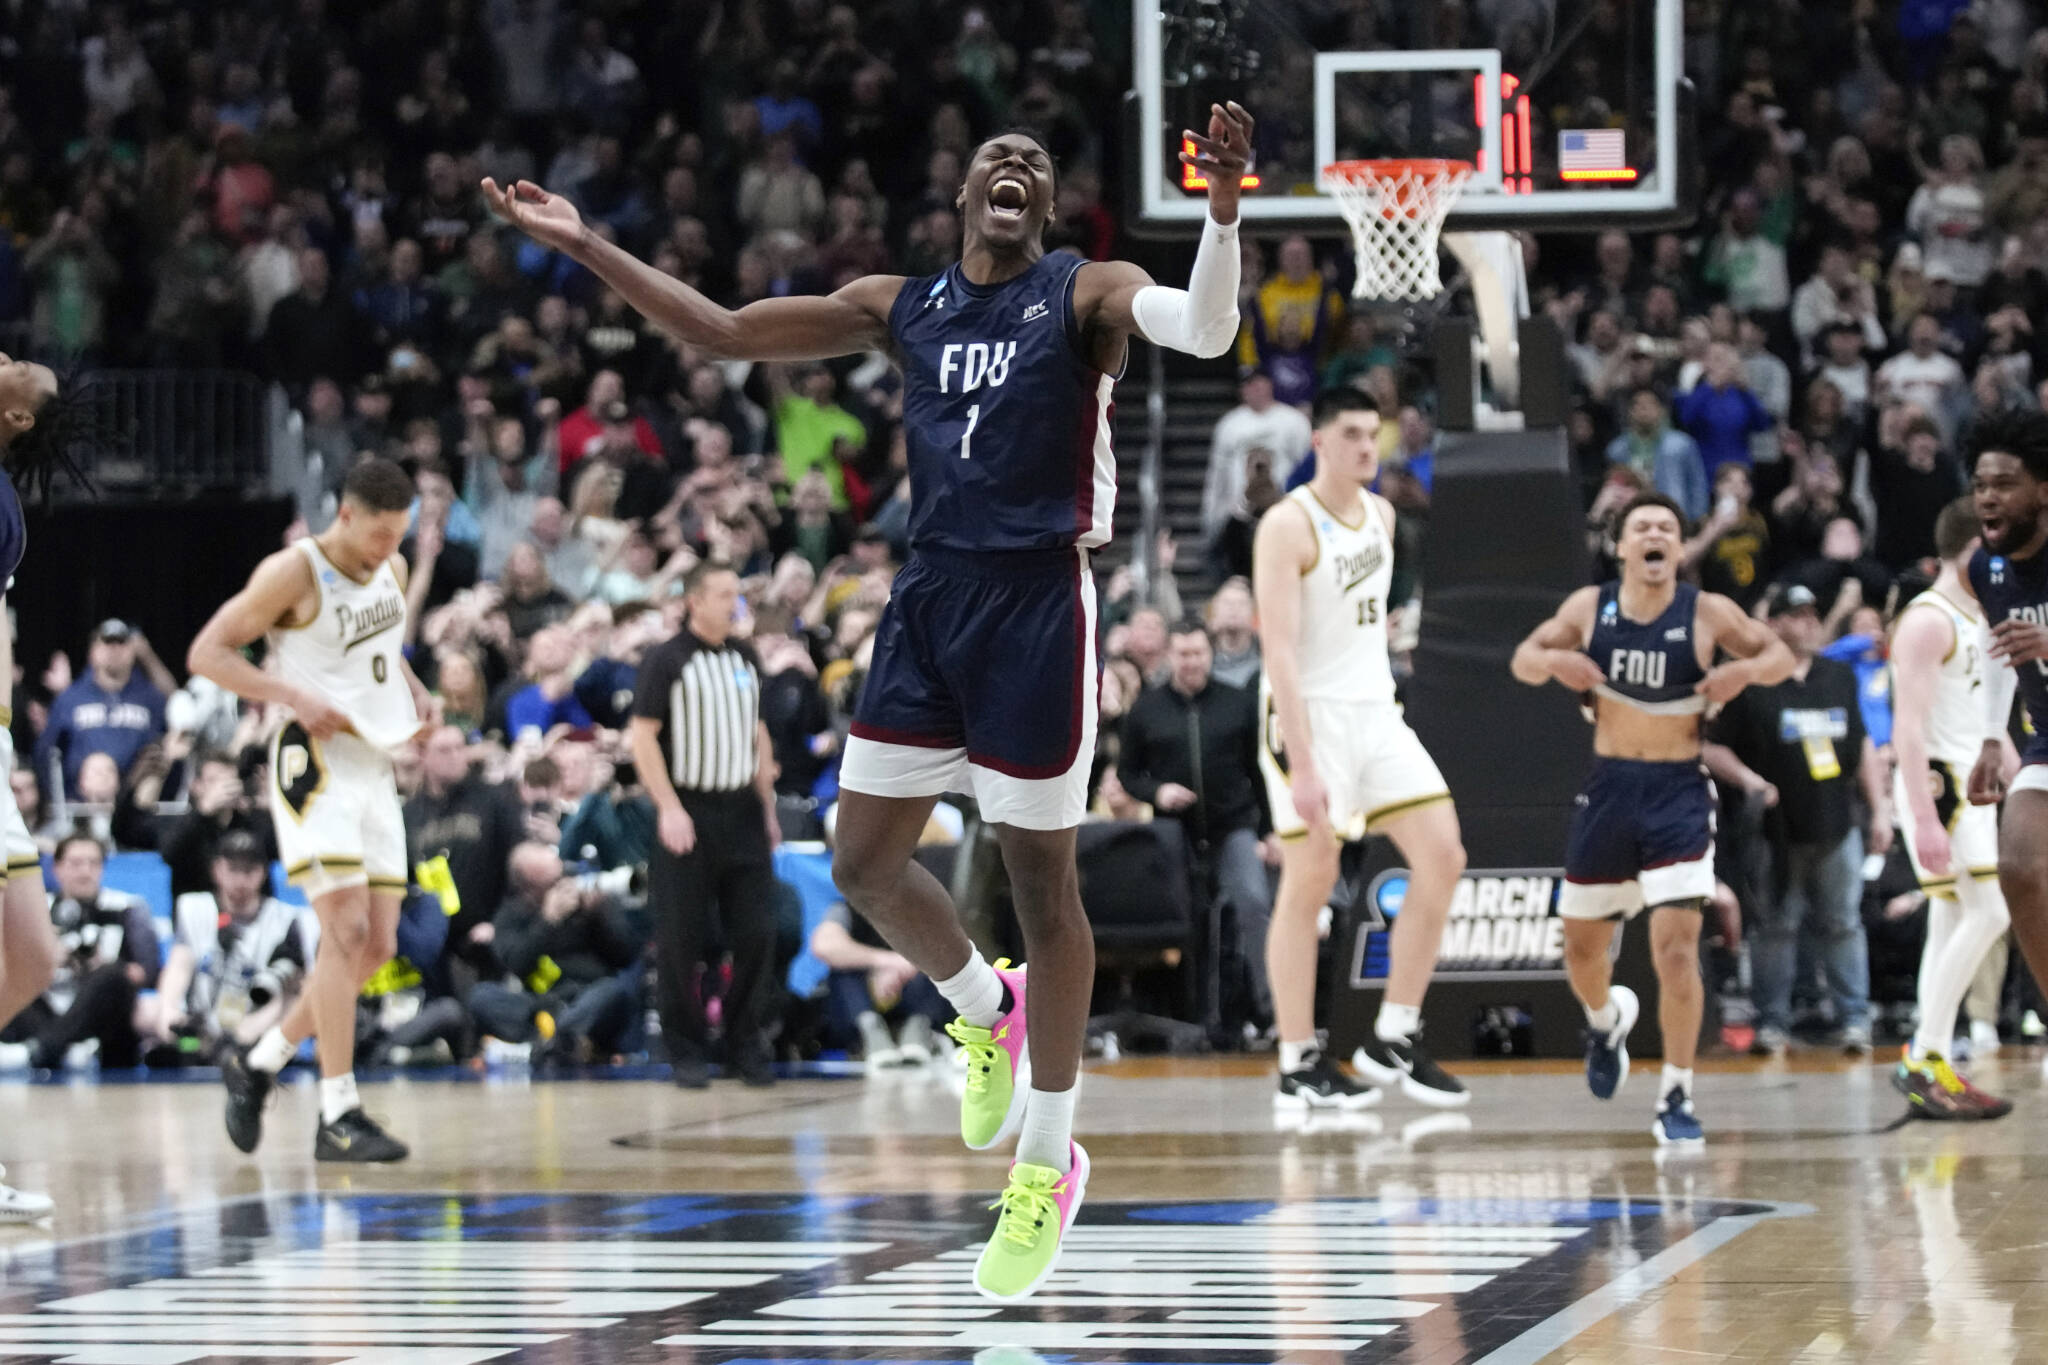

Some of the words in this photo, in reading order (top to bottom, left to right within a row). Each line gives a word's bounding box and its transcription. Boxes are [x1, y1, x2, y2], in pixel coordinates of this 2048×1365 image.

[939, 340, 1017, 394] FDU
[960, 404, 980, 460] 1
[1357, 597, 1378, 626] 15
[372, 654, 388, 684] 0
[1609, 648, 1667, 689] FDU
[280, 744, 309, 792] P
[1448, 876, 1553, 918] ARCH
[1439, 916, 1564, 961] MADNE
